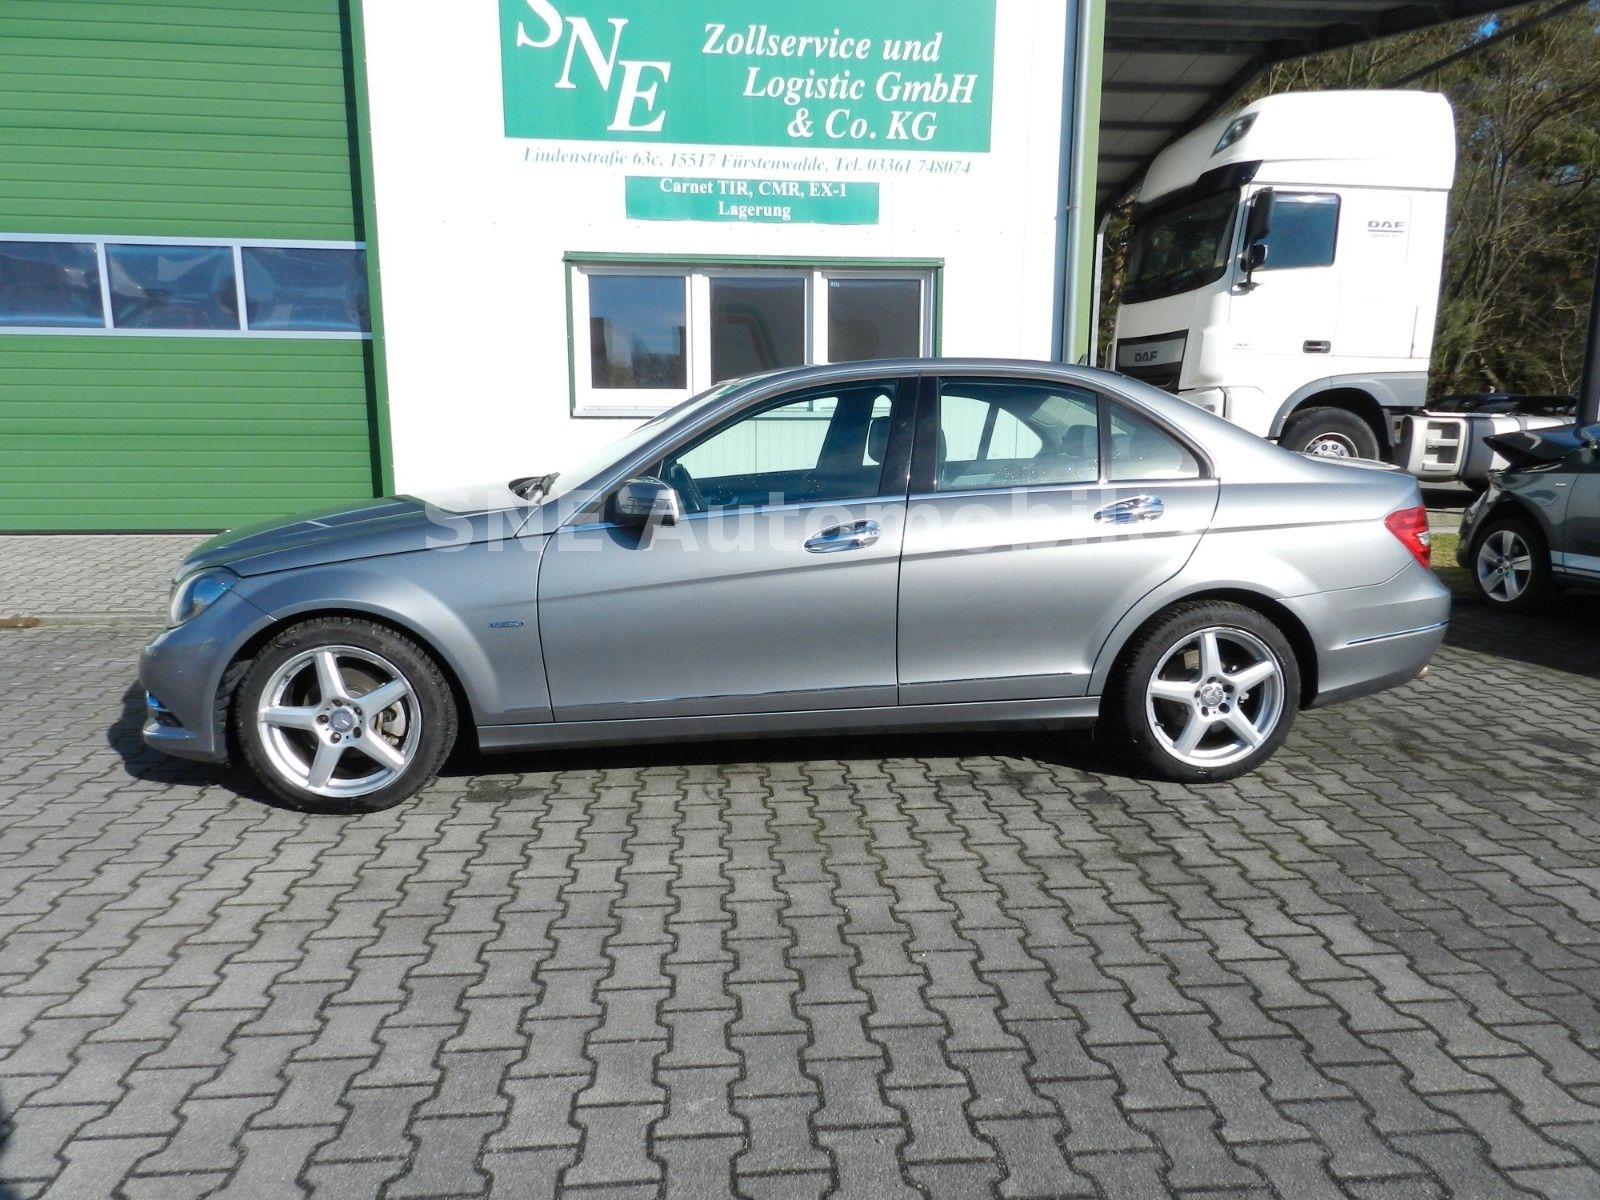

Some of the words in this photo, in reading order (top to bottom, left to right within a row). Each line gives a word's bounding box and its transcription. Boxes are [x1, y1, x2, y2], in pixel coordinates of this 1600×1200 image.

[702, 23, 871, 60] Zollservice
[882, 32, 943, 62] und
[743, 66, 865, 106] Logistic
[875, 71, 978, 103] GmbH
[787, 107, 814, 138] &
[825, 108, 877, 139] Co.
[886, 110, 937, 141] KG
[523, 146, 627, 168] Lindenstraße
[671, 153, 716, 169] 15517
[834, 156, 862, 171] Tel.
[867, 158, 911, 173] 03361
[918, 159, 972, 175] 748074
[659, 178, 713, 194] Carnet
[718, 180, 754, 198] TIR,
[759, 181, 805, 199] CMR,
[810, 182, 847, 198] EX-1
[718, 201, 792, 220] Lagerung
[1367, 220, 1405, 229] DAF
[1134, 350, 1158, 363] DAF
